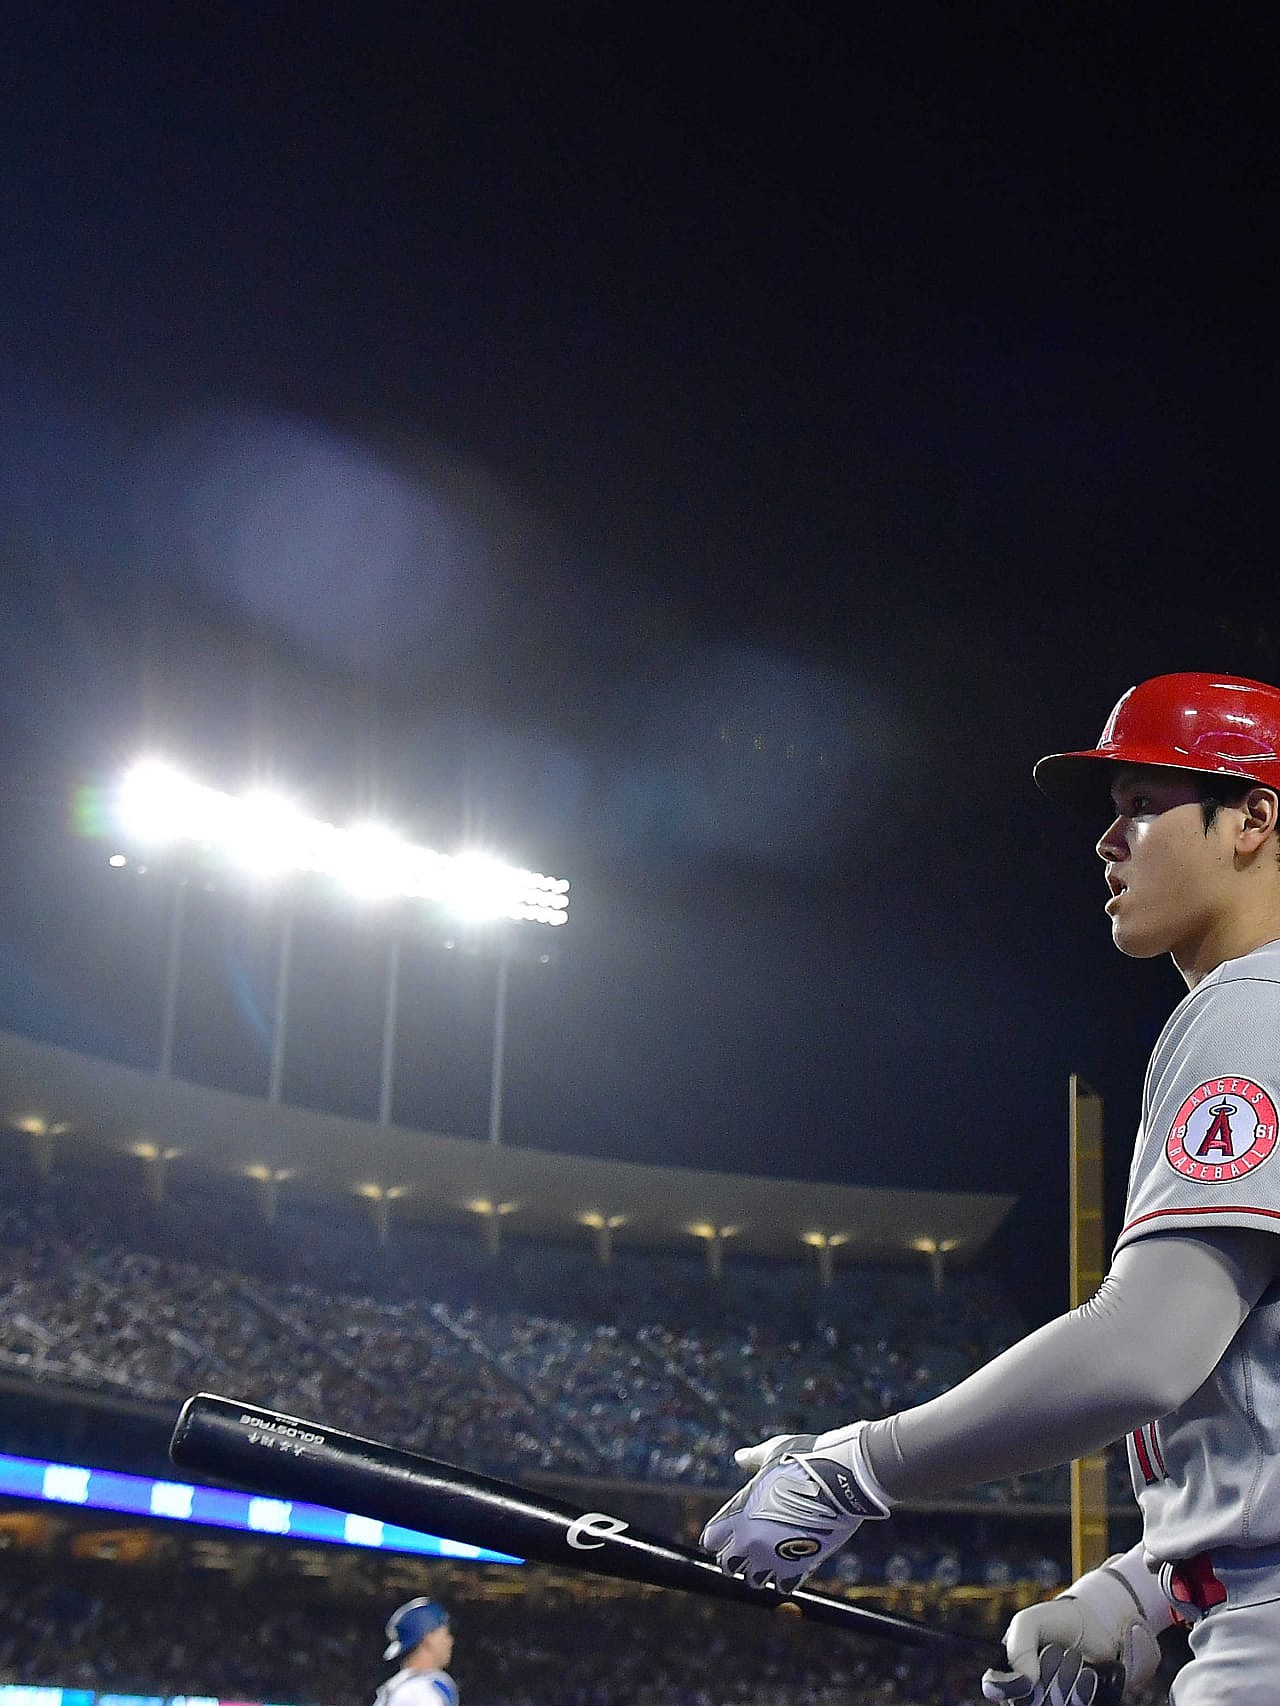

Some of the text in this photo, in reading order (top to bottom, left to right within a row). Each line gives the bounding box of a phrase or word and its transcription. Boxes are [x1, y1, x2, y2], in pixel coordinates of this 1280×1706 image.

[1190, 1079, 1265, 1107] ANGELS
[1170, 1124, 1274, 1140] 19 61
[1195, 1095, 1235, 1157] A
[1169, 1147, 1266, 1179] BASEBALL
